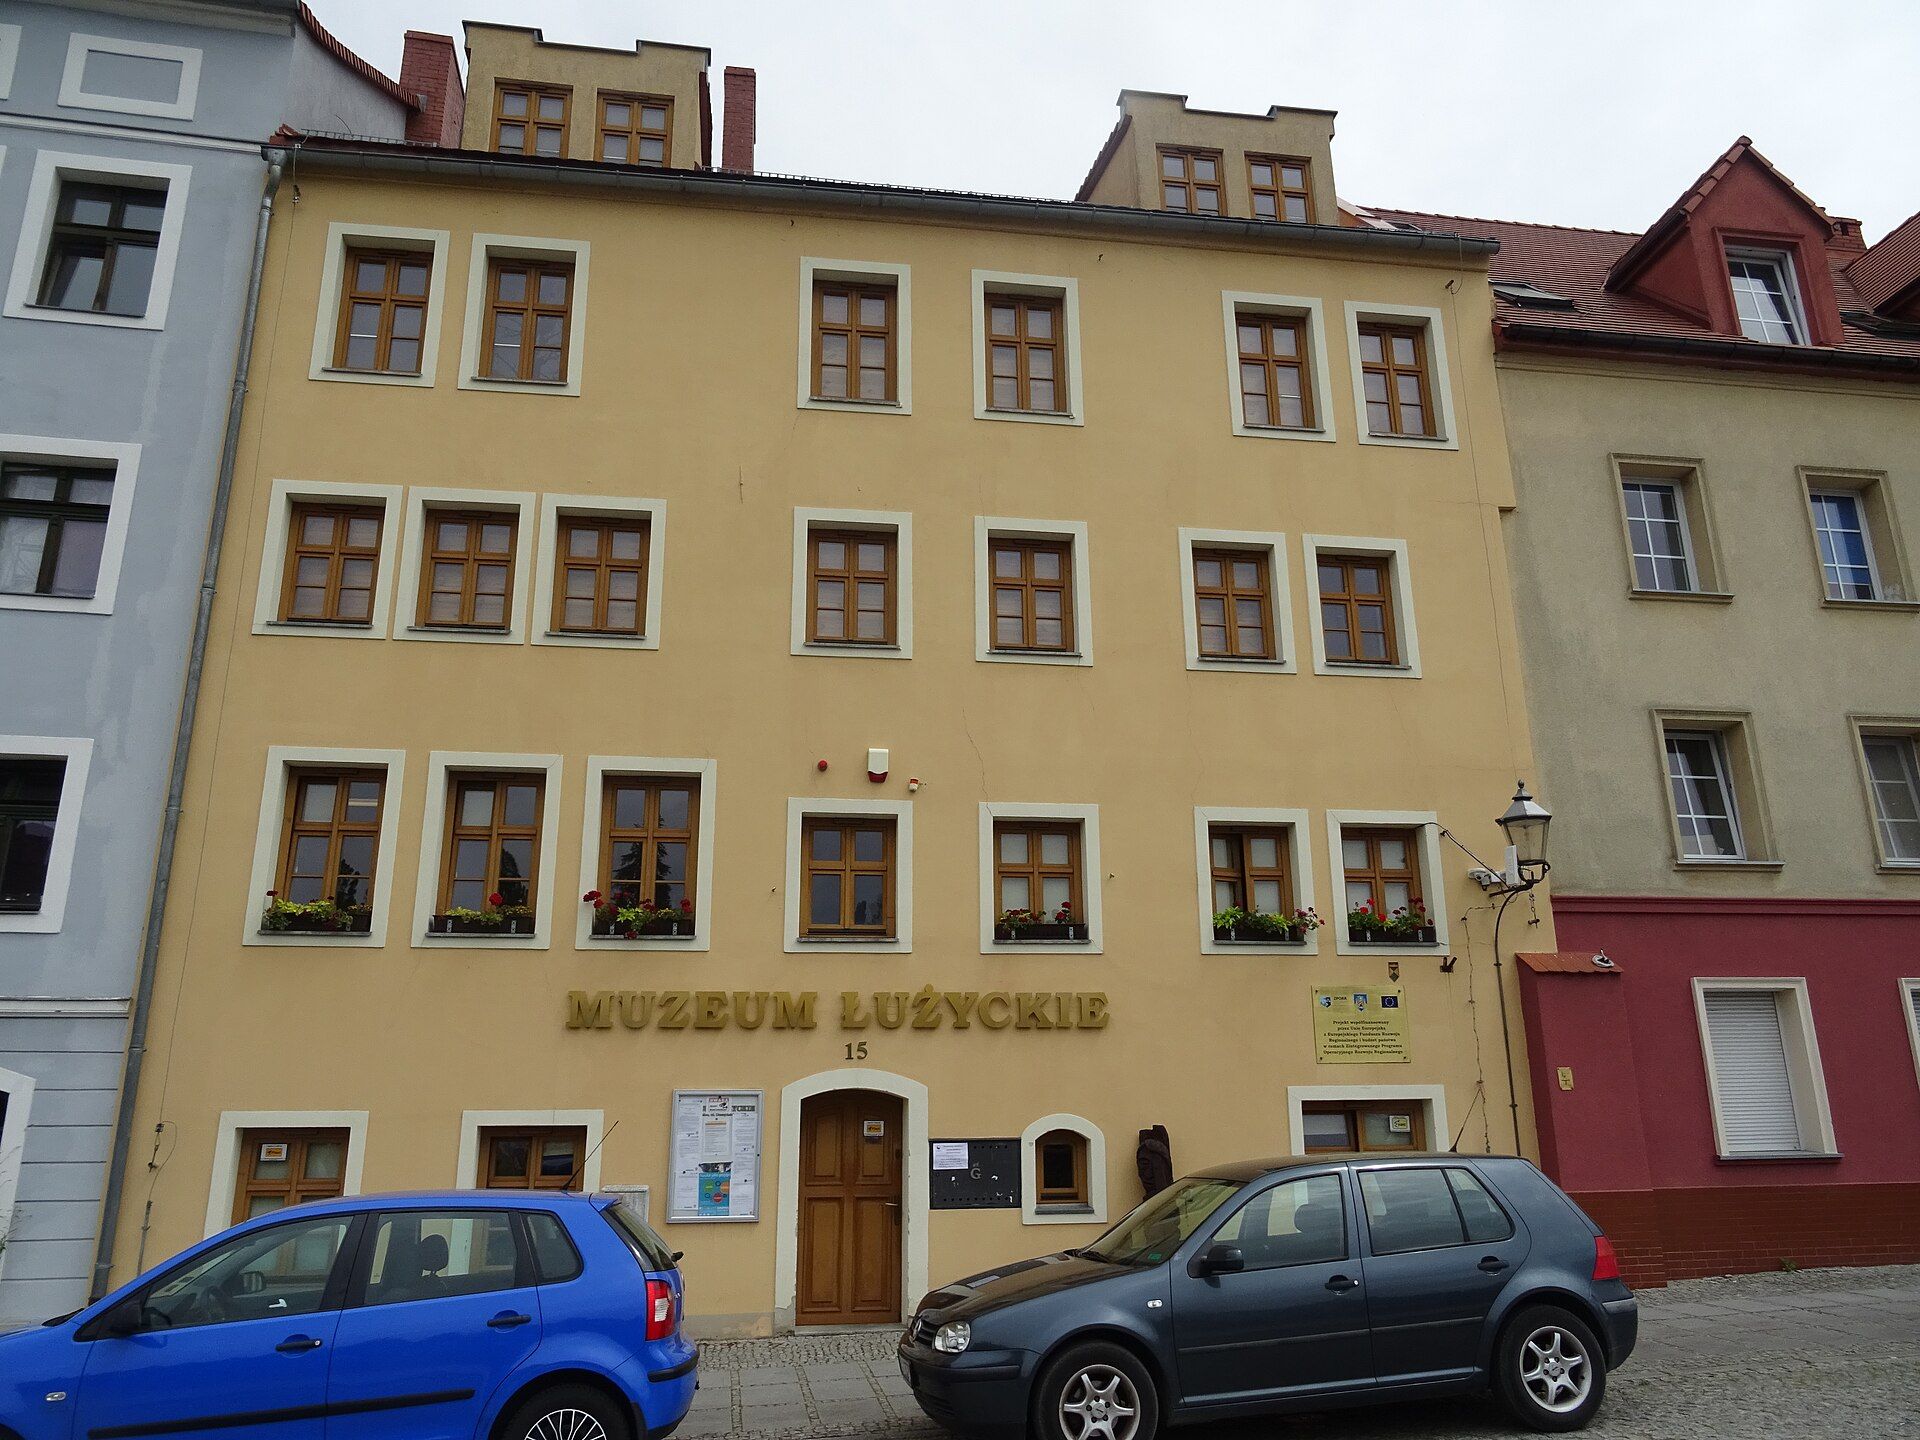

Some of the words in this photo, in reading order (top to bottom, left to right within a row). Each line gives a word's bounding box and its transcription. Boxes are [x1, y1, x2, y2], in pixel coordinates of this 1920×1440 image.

[565, 990, 818, 1030] MUZEUM
[840, 983, 1110, 1030] ŁUŻYCKIE
[845, 1041, 868, 1060] 15
[970, 1167, 981, 1179] G
